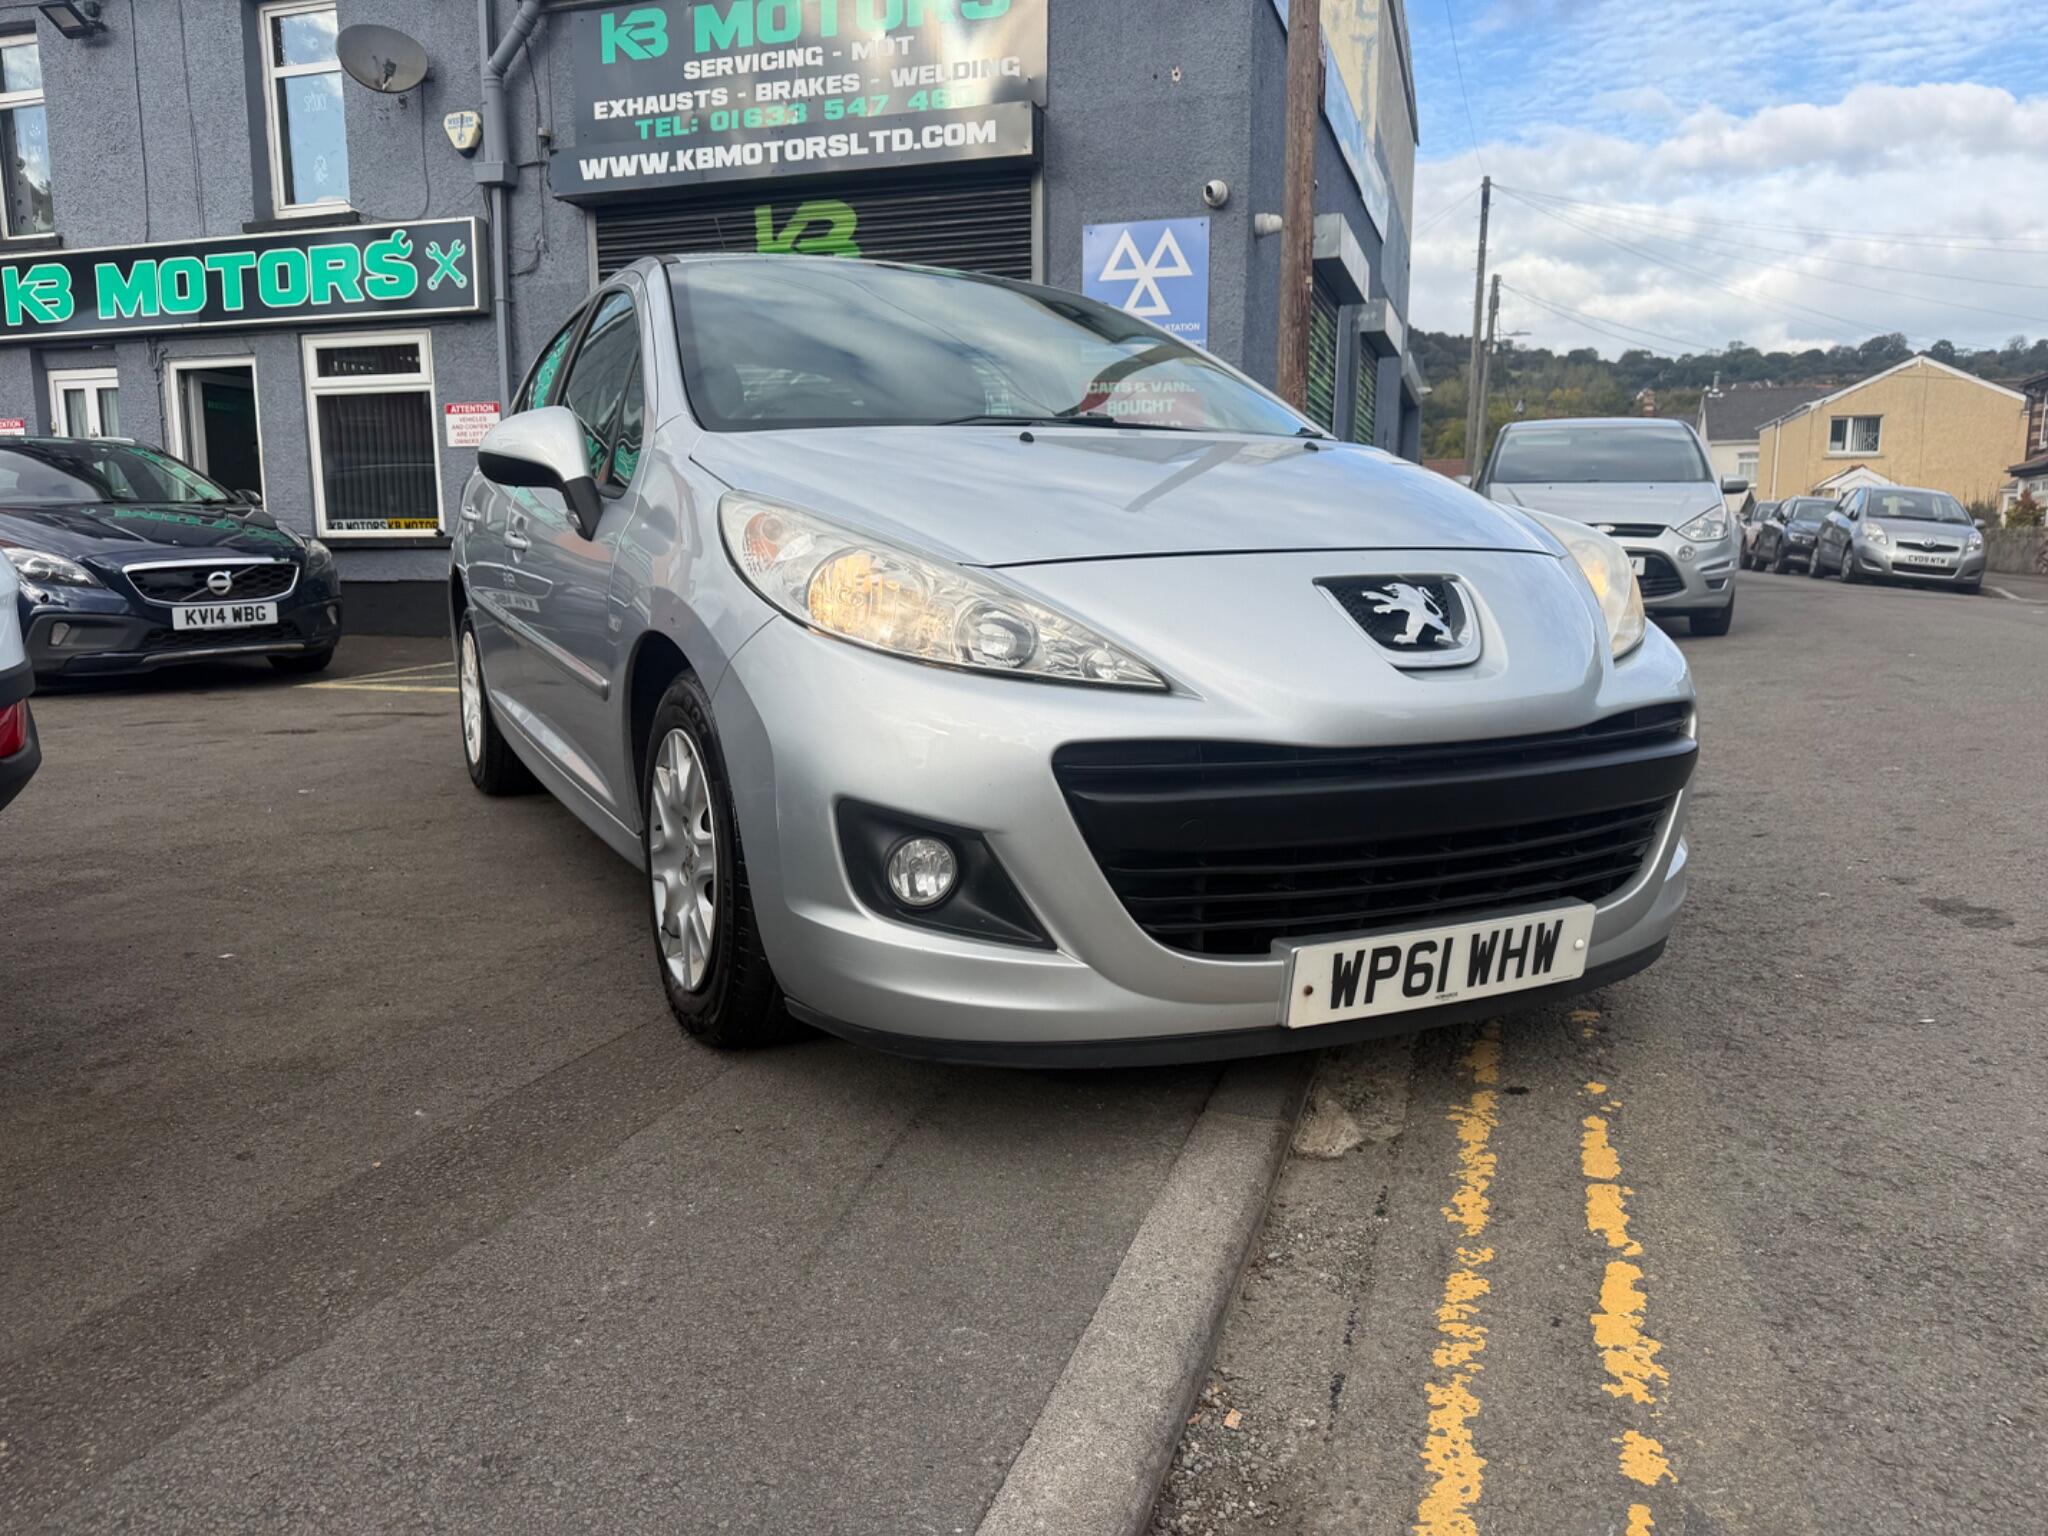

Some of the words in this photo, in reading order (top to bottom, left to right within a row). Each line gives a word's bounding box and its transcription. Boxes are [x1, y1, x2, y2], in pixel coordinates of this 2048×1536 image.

[600, 8, 669, 64] KB
[683, 46, 823, 80] SERVICING
[851, 36, 914, 61] MOT
[593, 87, 728, 120] EXHAUSTS
[755, 73, 860, 102] BRAKES
[890, 56, 1021, 88] WELDING
[635, 117, 698, 140] TEL:
[710, 102, 807, 132] 01633
[823, 94, 889, 120] 547
[578, 119, 997, 181] WWW.KBMOTORSLTD.COM
[2, 263, 75, 326] KB
[95, 229, 418, 320] MOTORS
[451, 404, 495, 413] ATTENTION
[1088, 382, 1132, 393] CARS
[1107, 399, 1176, 416] BOUGHT
[346, 520, 386, 530] MOTORS
[185, 607, 226, 626] KV14
[231, 605, 267, 623] WBG
[1330, 937, 1454, 1010] WP61
[1467, 919, 1564, 988] WHW
